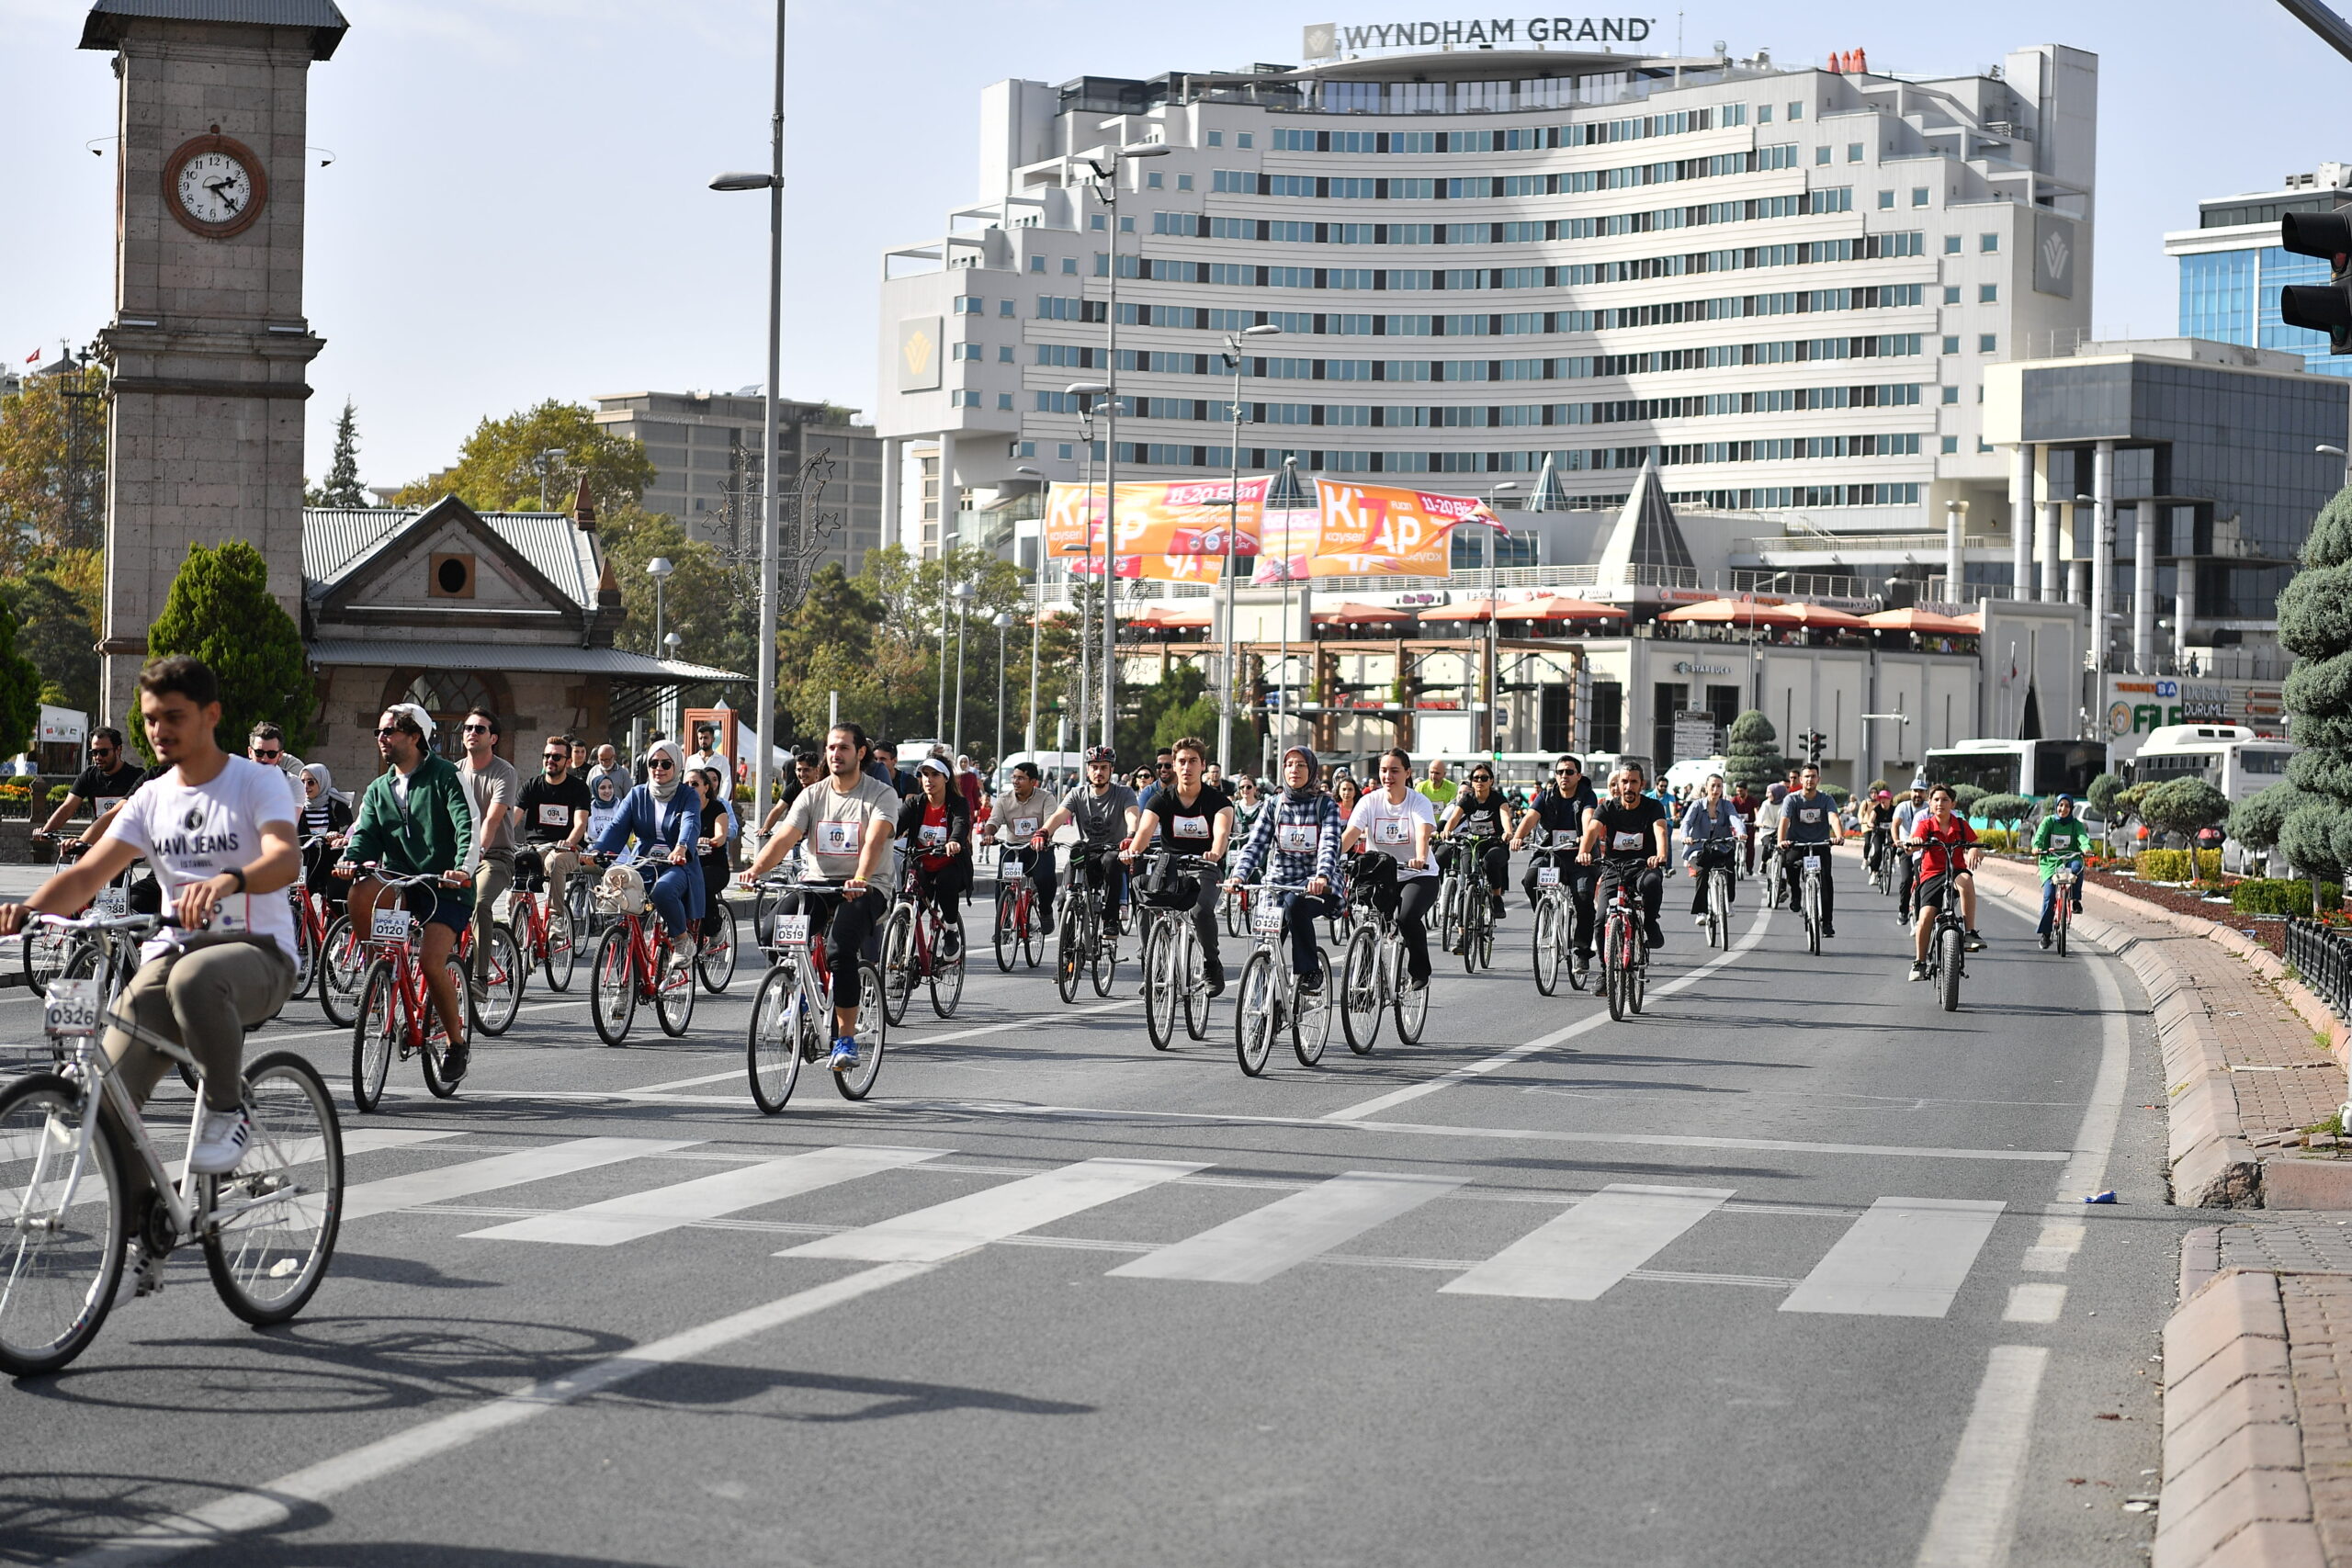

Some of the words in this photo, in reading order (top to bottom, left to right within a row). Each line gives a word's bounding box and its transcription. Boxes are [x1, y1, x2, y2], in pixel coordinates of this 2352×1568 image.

[1344, 18, 1514, 49] WYNDHAM
[1528, 17, 1650, 42] GRAND
[196, 160, 203, 170] 11
[209, 157, 220, 166] 12
[186, 171, 198, 180] 10
[235, 169, 241, 179] 2
[183, 181, 189, 191] 9
[239, 184, 245, 194] 3
[187, 194, 194, 204] 8
[197, 204, 204, 214] 7
[209, 208, 216, 218] 6
[1421, 497, 1453, 514] 11-20
[1474, 809, 1489, 818] NIKE
[1183, 823, 1198, 831] 123
[1290, 833, 1306, 842] 102
[191, 833, 239, 854] JEANS
[376, 925, 403, 935] 0120
[778, 931, 804, 940] 0519
[51, 1010, 94, 1025] 0326
